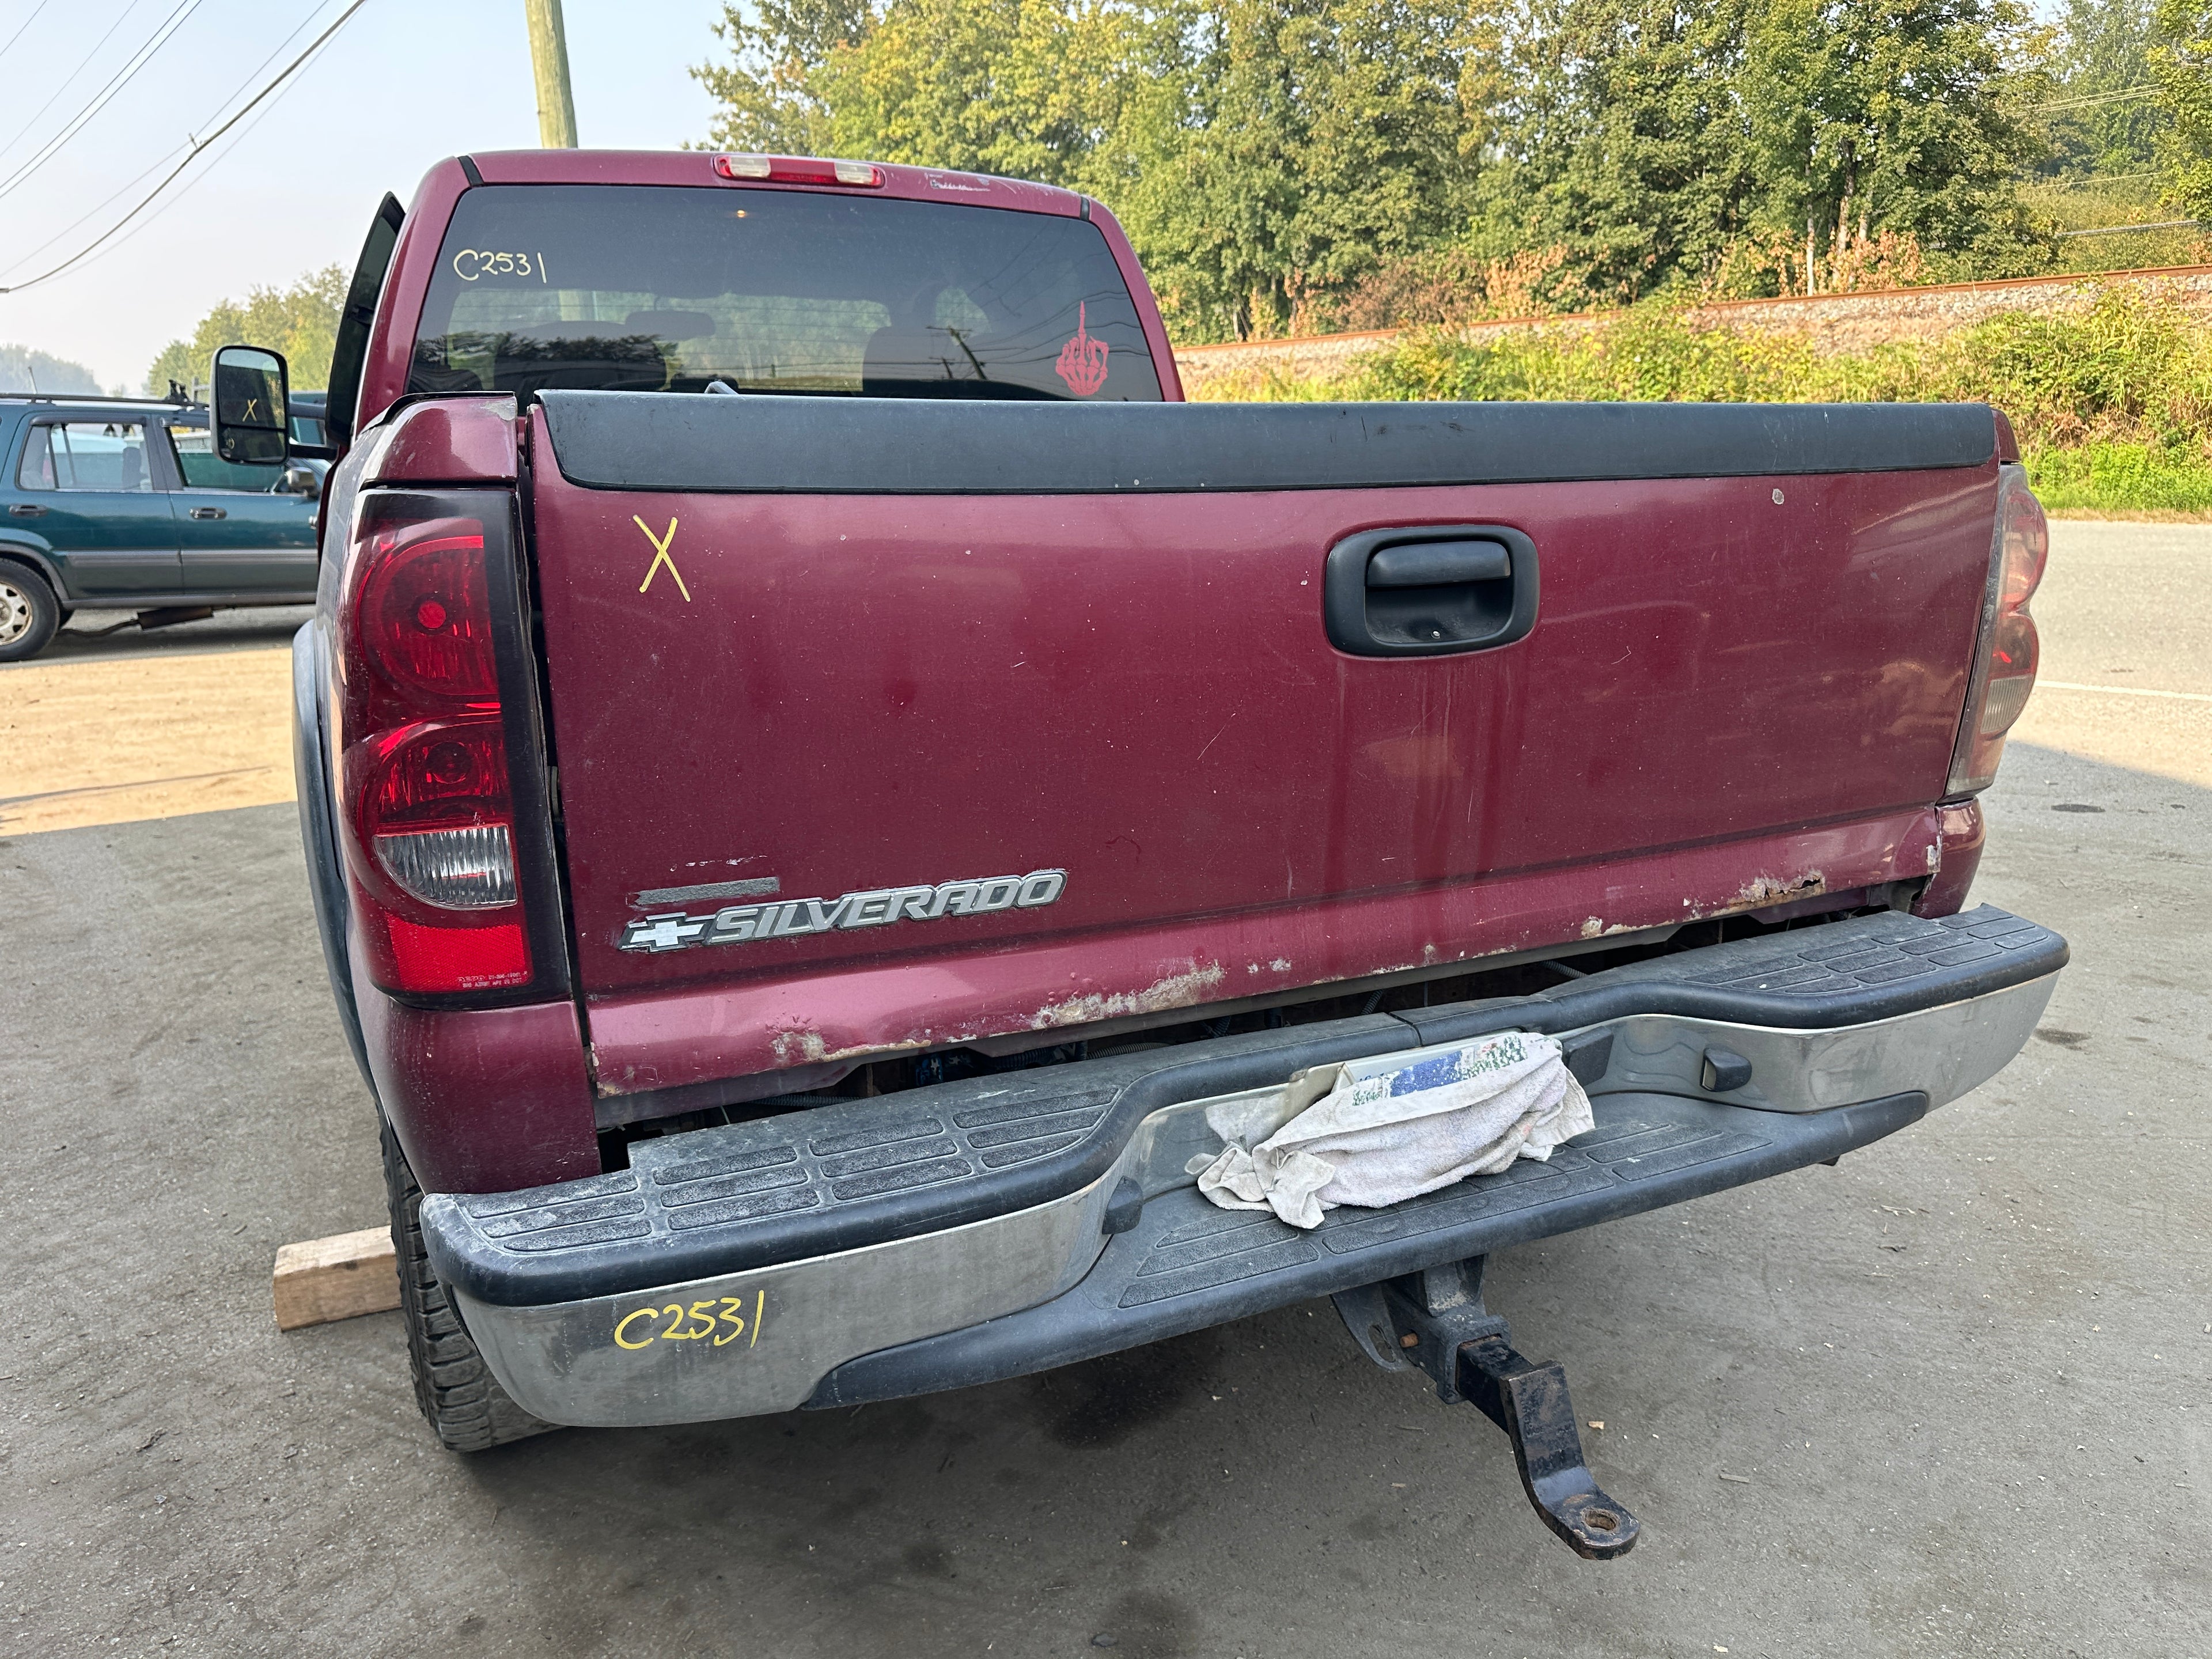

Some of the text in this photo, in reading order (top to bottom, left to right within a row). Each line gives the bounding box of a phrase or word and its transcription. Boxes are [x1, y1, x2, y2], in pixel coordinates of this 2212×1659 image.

[453, 248, 547, 284] C2531
[707, 871, 1066, 945] SILVERADO
[614, 1290, 764, 1350] C2531
